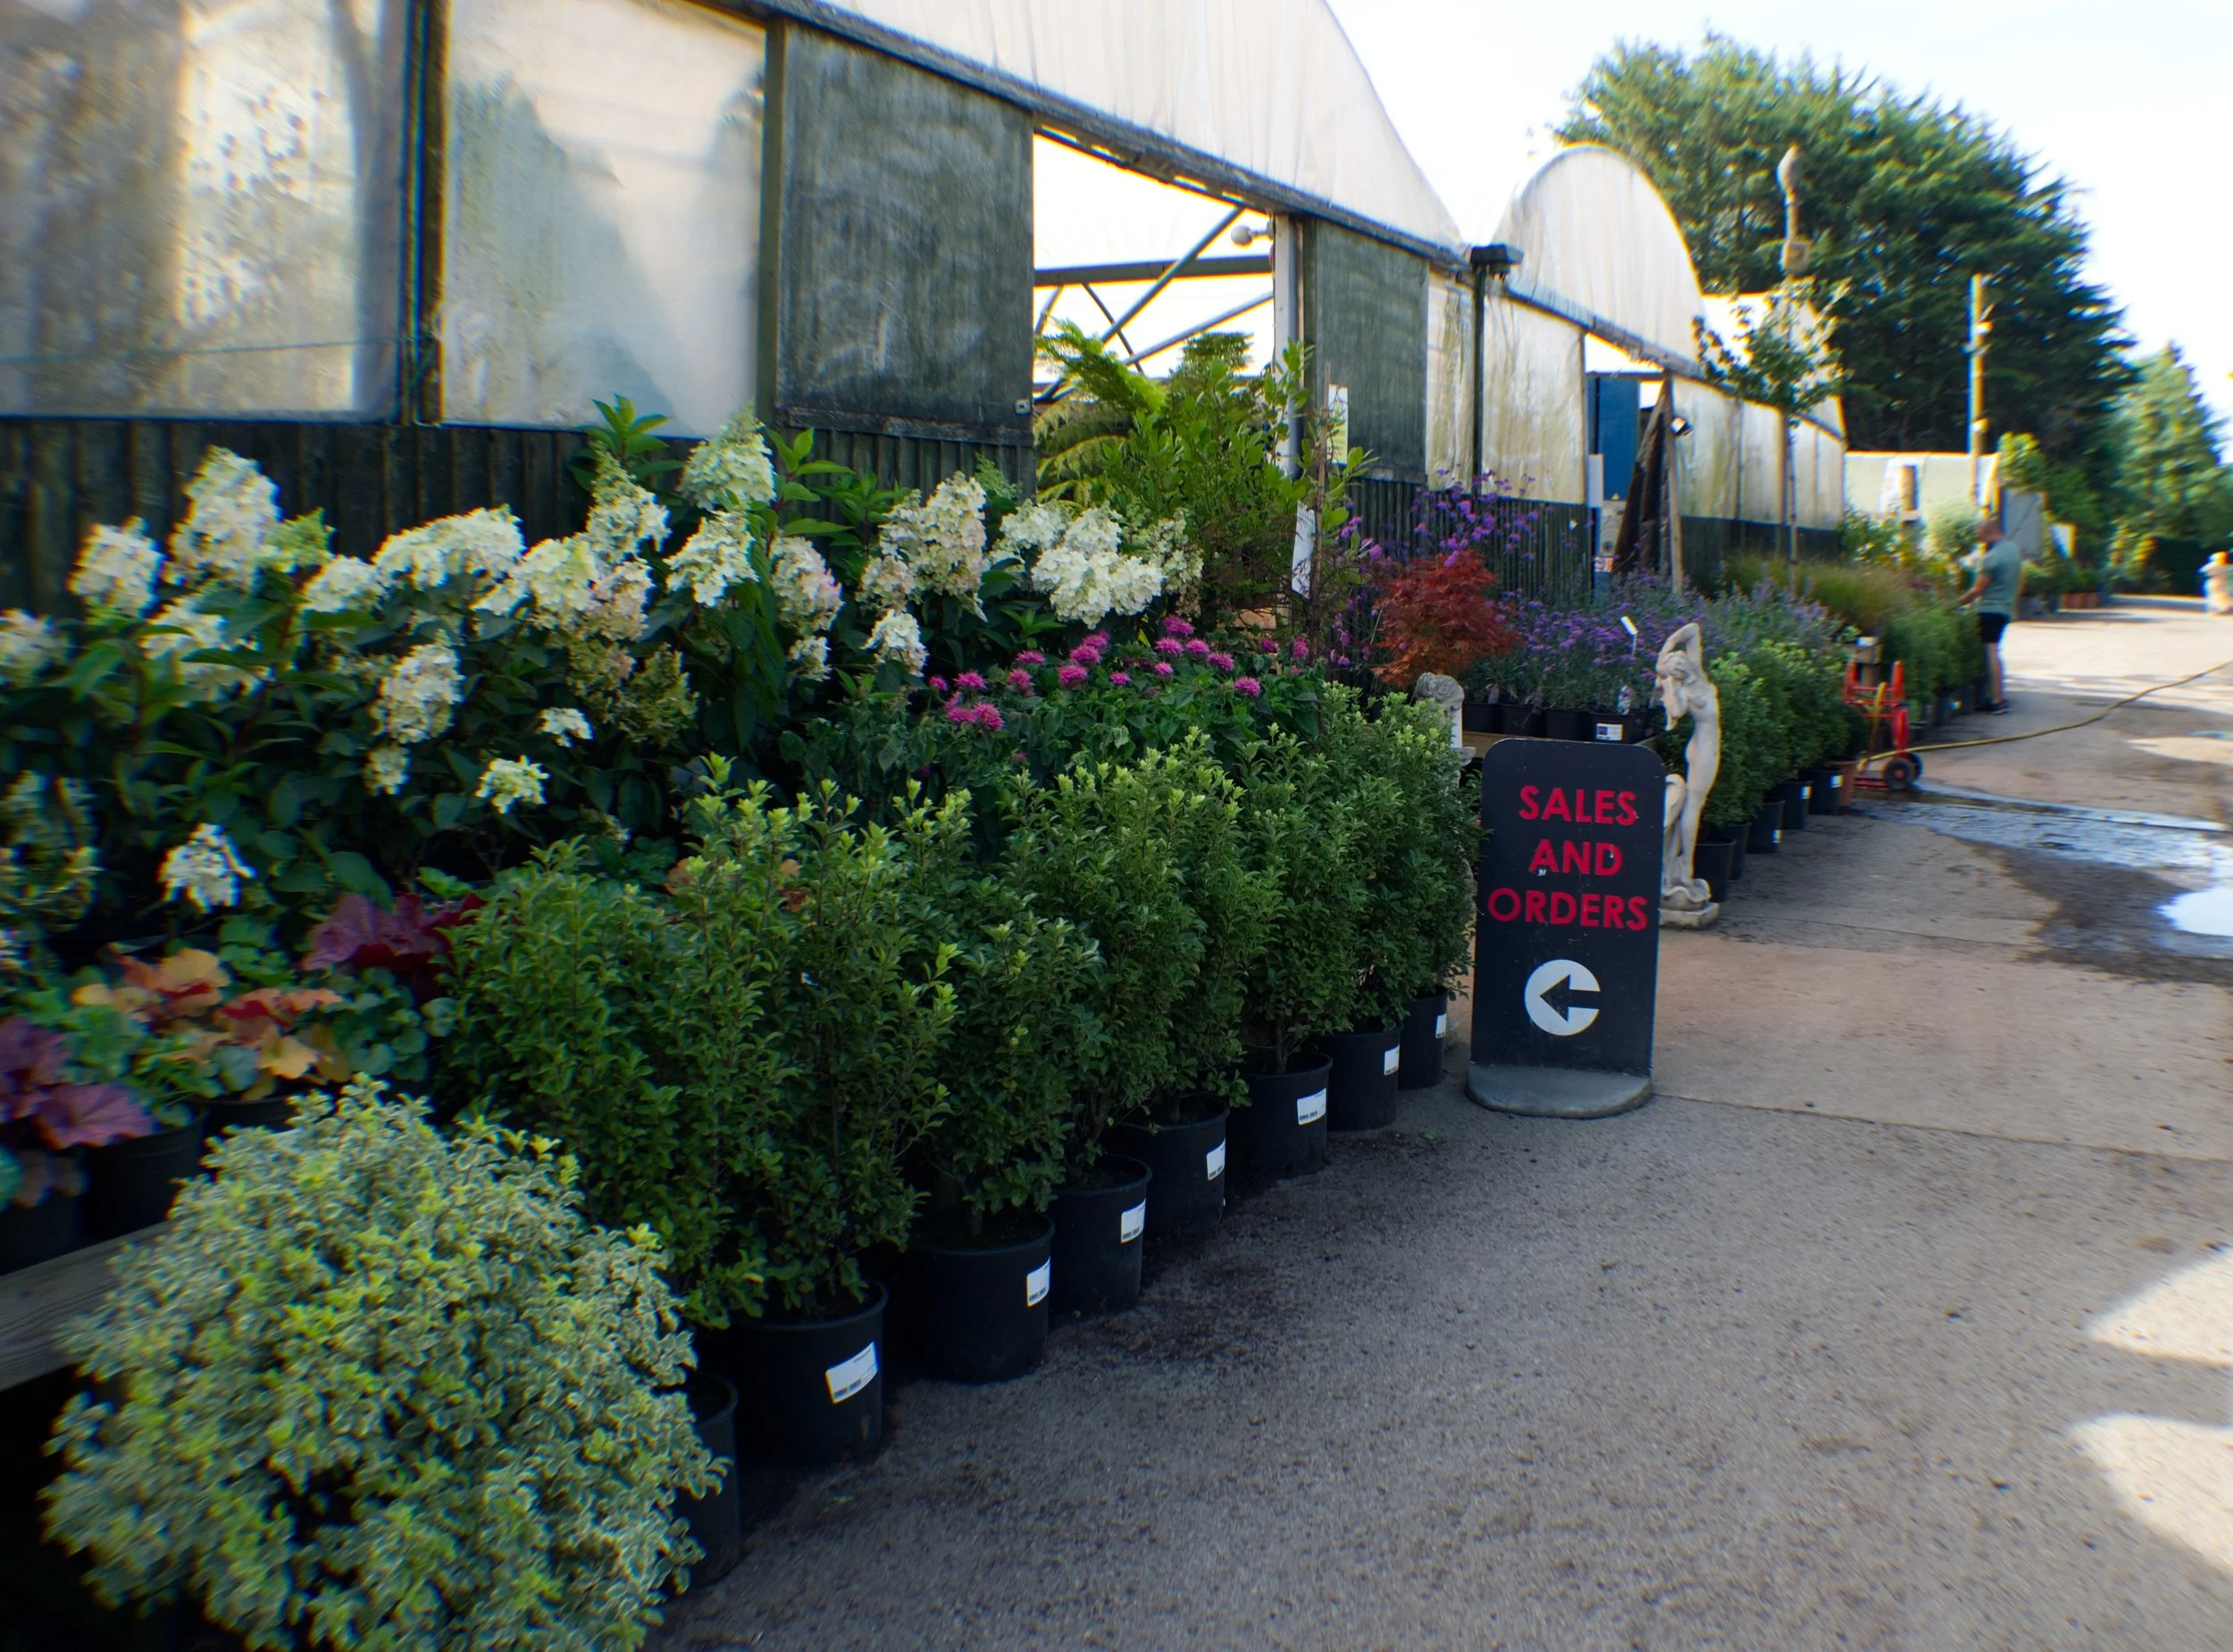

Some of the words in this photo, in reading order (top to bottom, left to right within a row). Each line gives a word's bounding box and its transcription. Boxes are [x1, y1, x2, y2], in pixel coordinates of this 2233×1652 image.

[1518, 785, 1638, 826] SALES
[1529, 839, 1623, 876] AND
[1487, 888, 1648, 931] ORDERS
